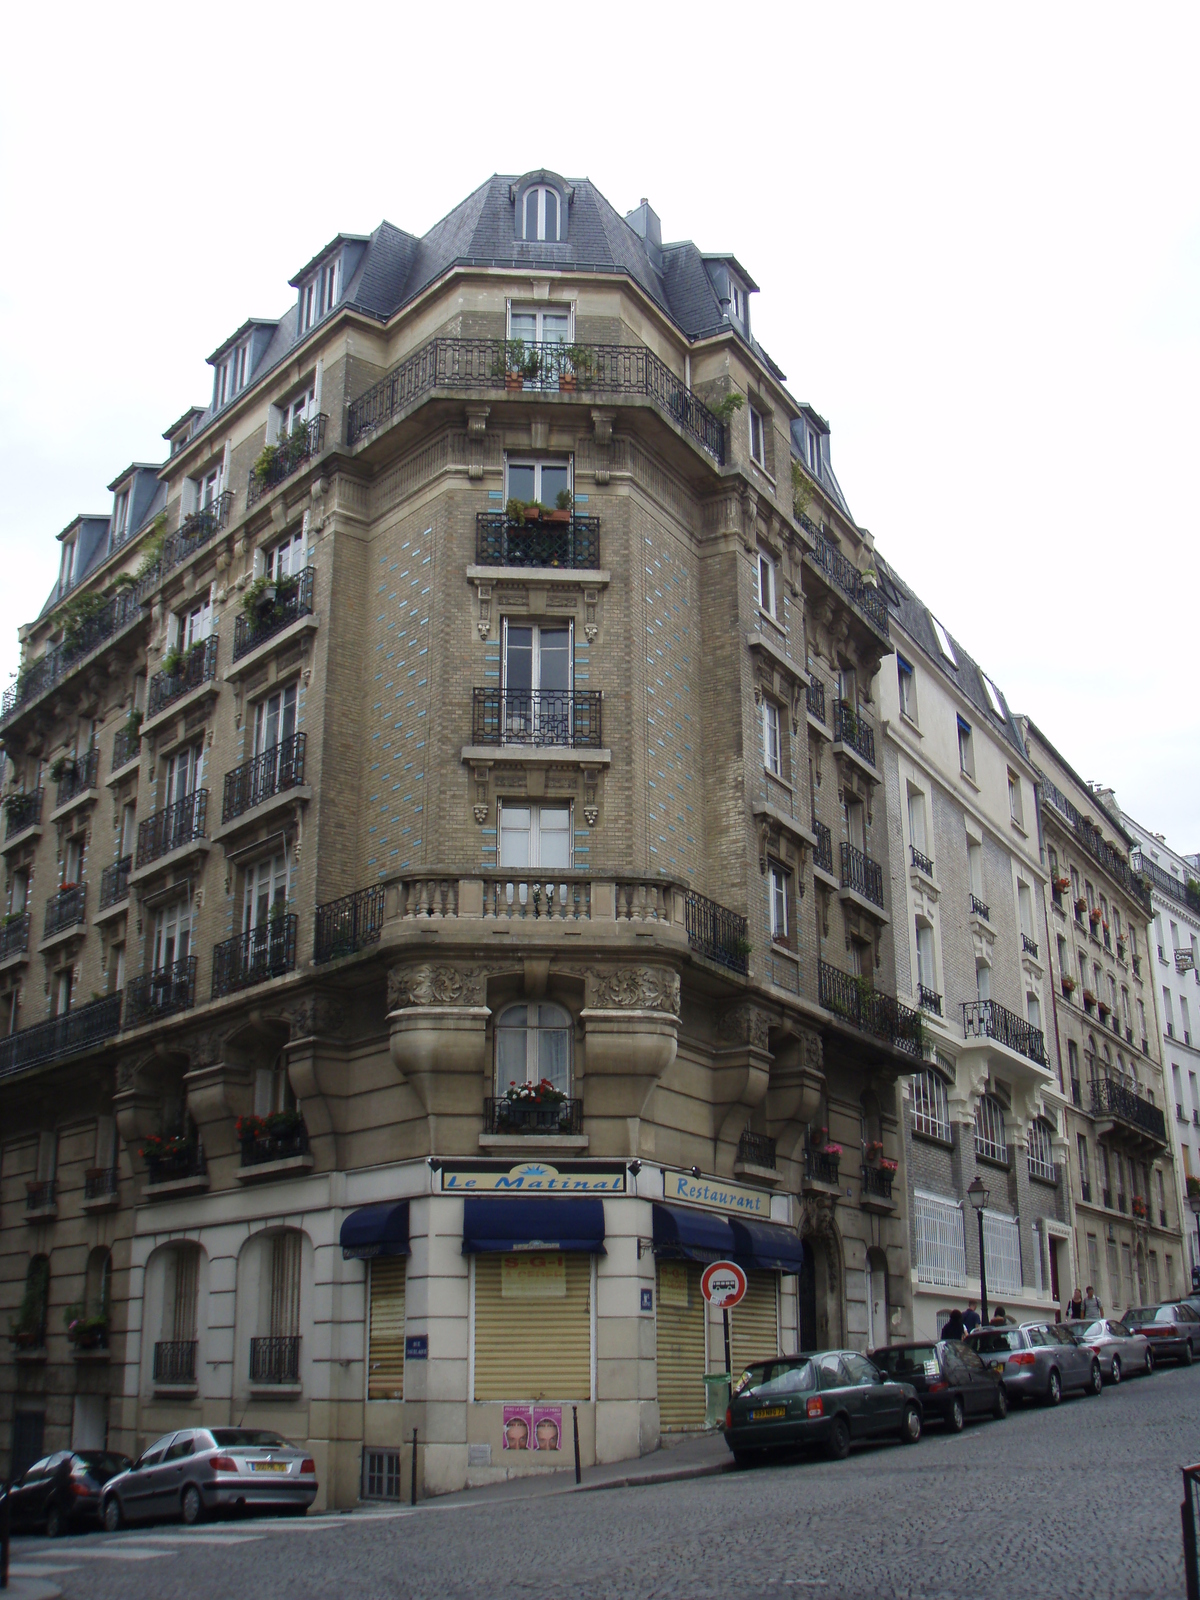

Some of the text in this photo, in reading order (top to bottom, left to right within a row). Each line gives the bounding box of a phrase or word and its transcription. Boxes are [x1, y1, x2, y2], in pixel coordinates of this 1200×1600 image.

[447, 1175, 621, 1189] Le Matinal
[677, 1178, 761, 1210] Restaurant
